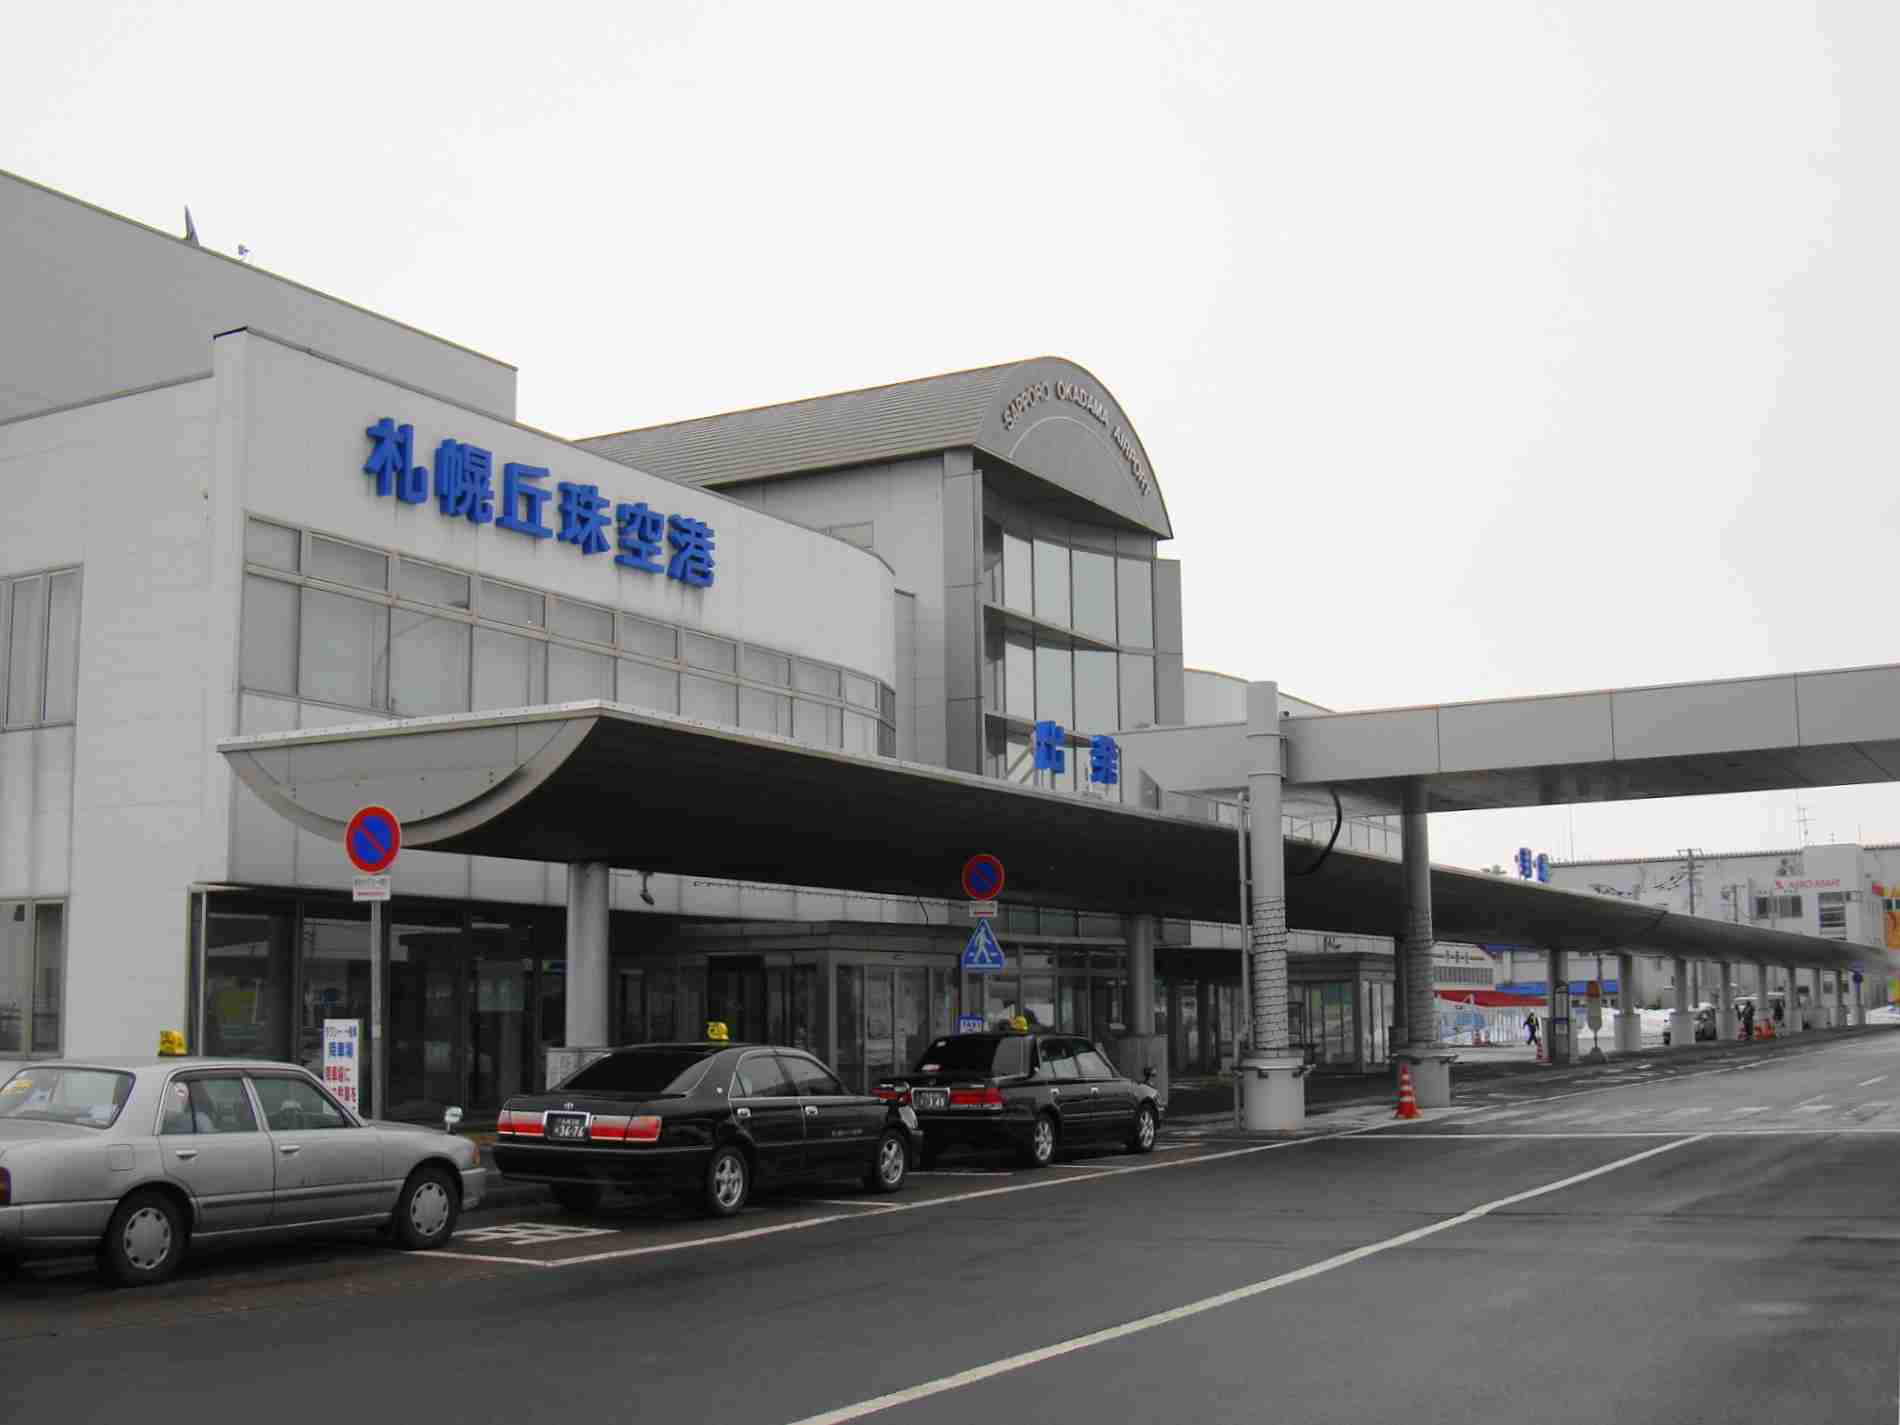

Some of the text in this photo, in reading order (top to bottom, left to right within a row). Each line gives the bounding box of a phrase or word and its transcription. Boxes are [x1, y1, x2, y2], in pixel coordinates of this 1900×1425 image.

[363, 417, 716, 588] 札幌丘珠空港
[1001, 378, 1151, 496] SAPPORO OKADAMA AIRPORT
